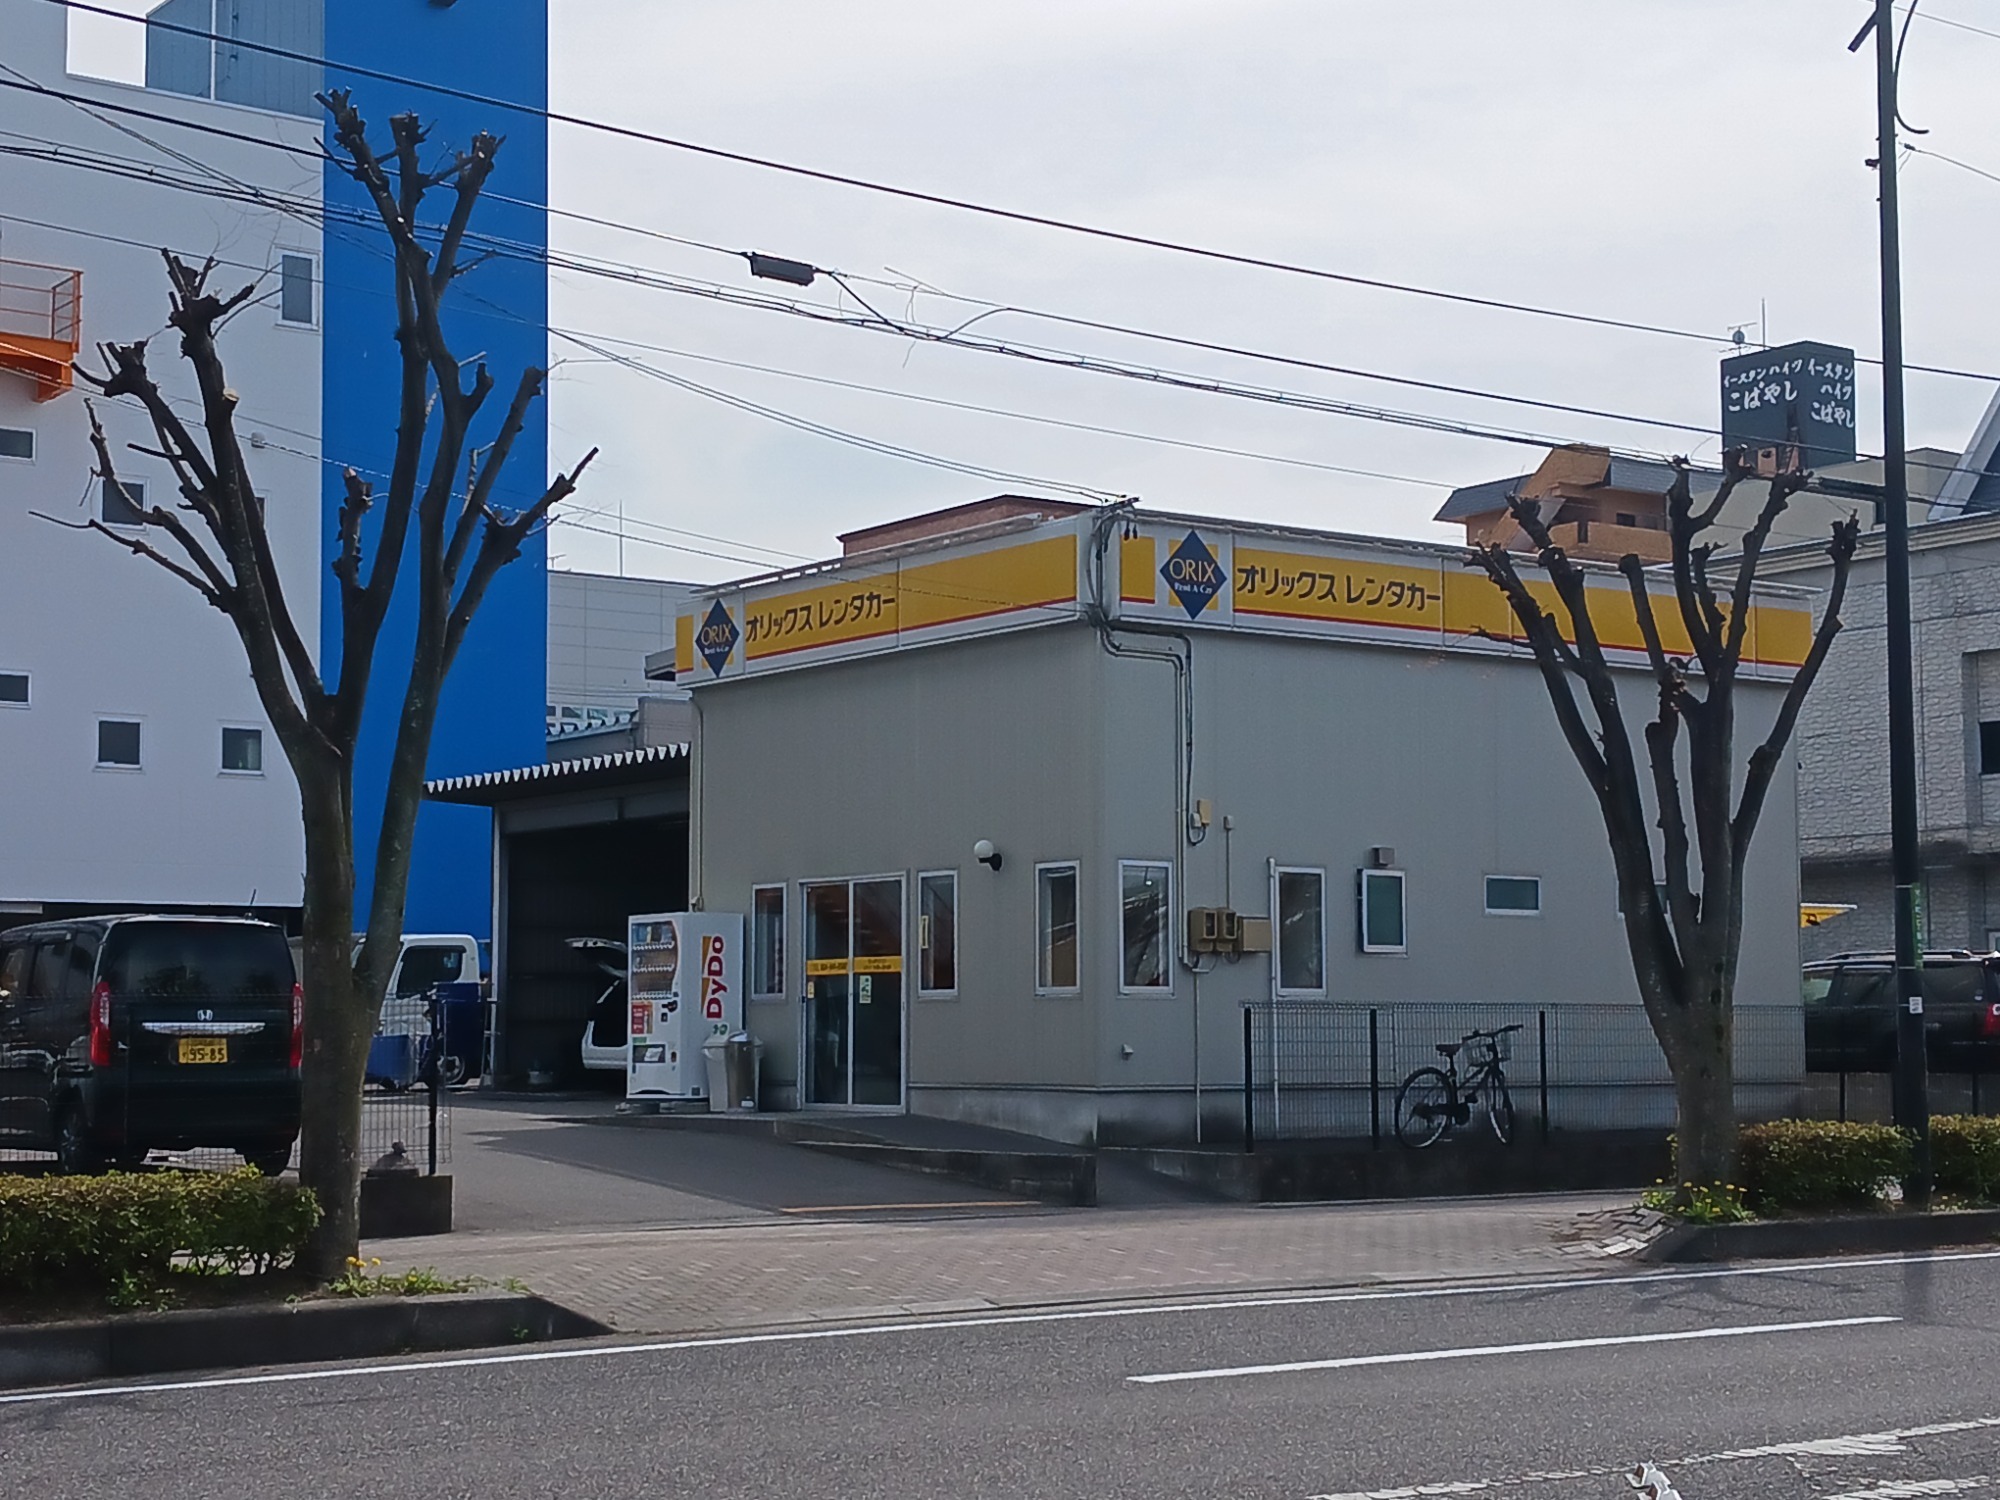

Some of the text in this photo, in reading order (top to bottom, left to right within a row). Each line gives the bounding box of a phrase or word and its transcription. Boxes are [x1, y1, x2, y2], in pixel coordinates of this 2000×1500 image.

[1807, 358, 1854, 381] イースタン
[1728, 381, 1798, 412] こばやし
[1811, 401, 1855, 428] こばやし
[1169, 558, 1216, 584] ORIX
[701, 624, 732, 645] ORIX
[707, 936, 728, 1018] DyDo
